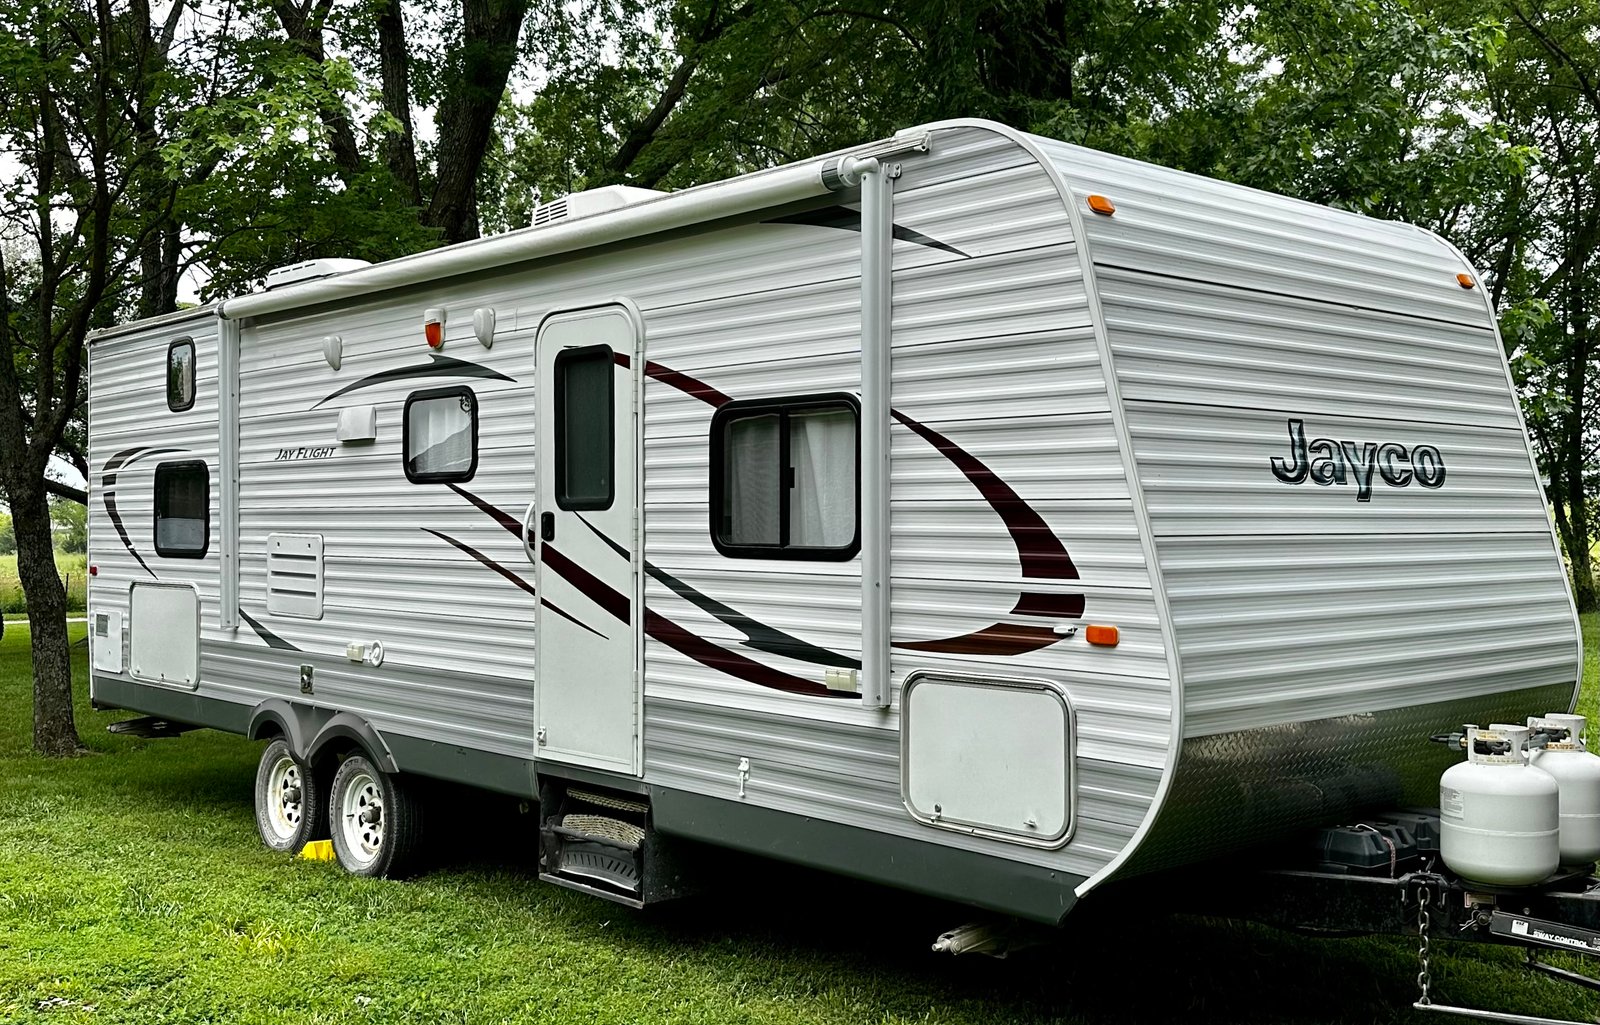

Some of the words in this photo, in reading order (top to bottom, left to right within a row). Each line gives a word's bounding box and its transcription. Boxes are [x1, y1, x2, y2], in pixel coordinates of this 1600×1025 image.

[275, 449, 295, 460] JAY
[296, 447, 336, 459] FLIGHT
[1270, 418, 1446, 502] Jayco
[1533, 931, 1554, 941] SWAY
[1555, 935, 1587, 947] CONTROL
